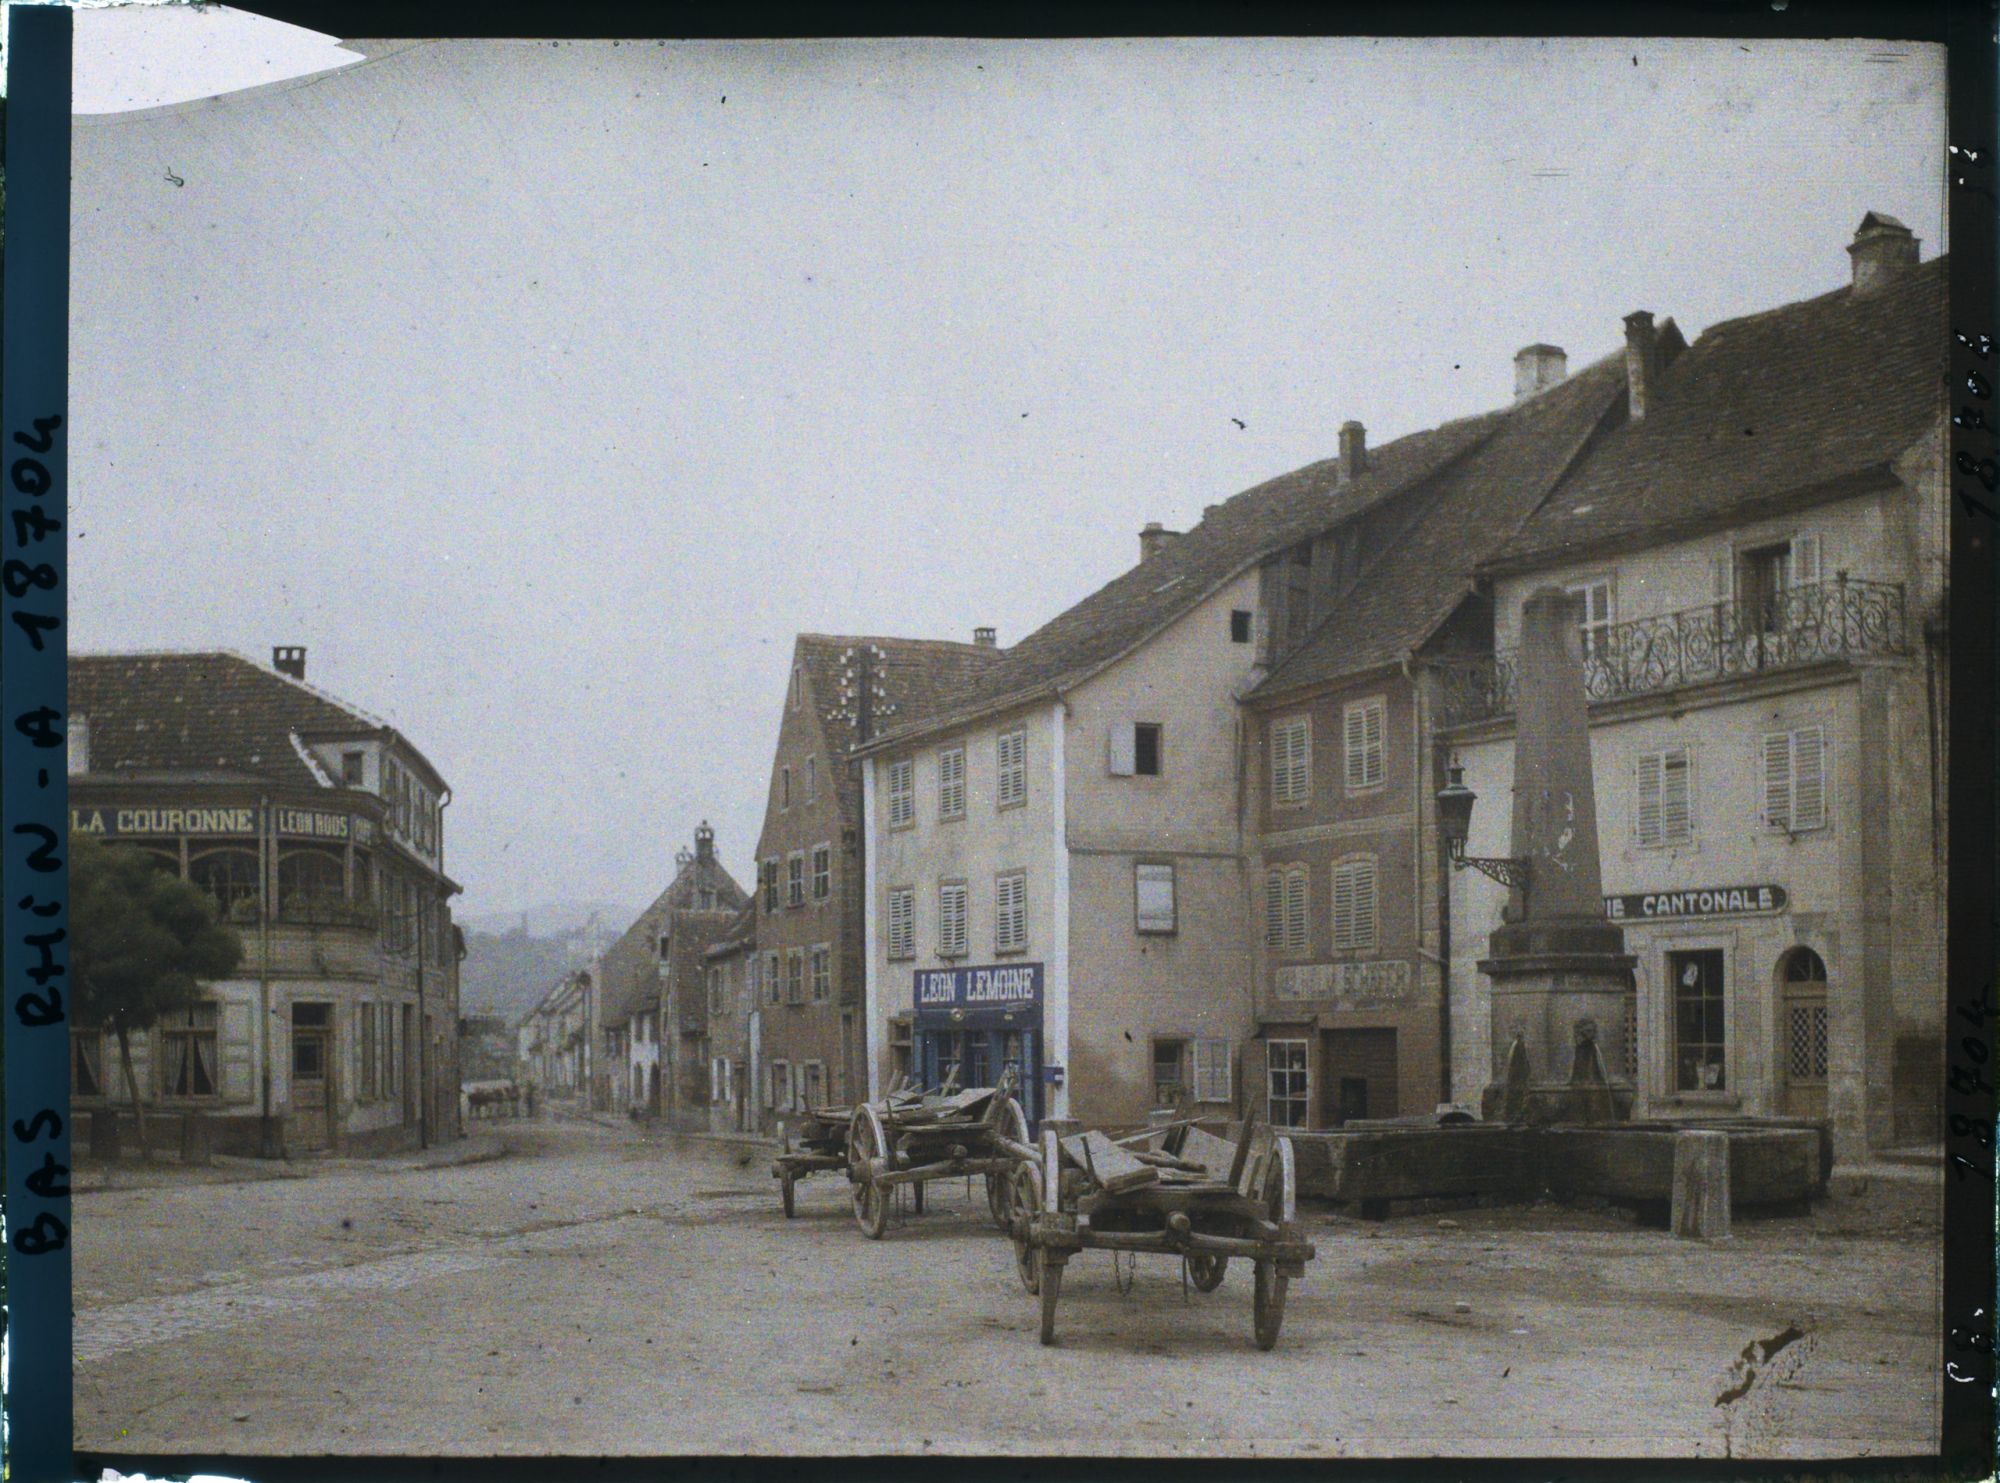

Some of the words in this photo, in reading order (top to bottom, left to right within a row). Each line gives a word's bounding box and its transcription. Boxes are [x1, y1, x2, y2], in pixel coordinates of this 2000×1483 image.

[3, 413, 63, 651] 18704
[71, 809, 106, 833] LA
[117, 809, 253, 833] COURONNE
[1643, 887, 1773, 916] CANTONALE
[920, 972, 957, 1003] LEON
[966, 967, 1035, 1001] LEMOINE
[13, 1107, 70, 1255] BAS
